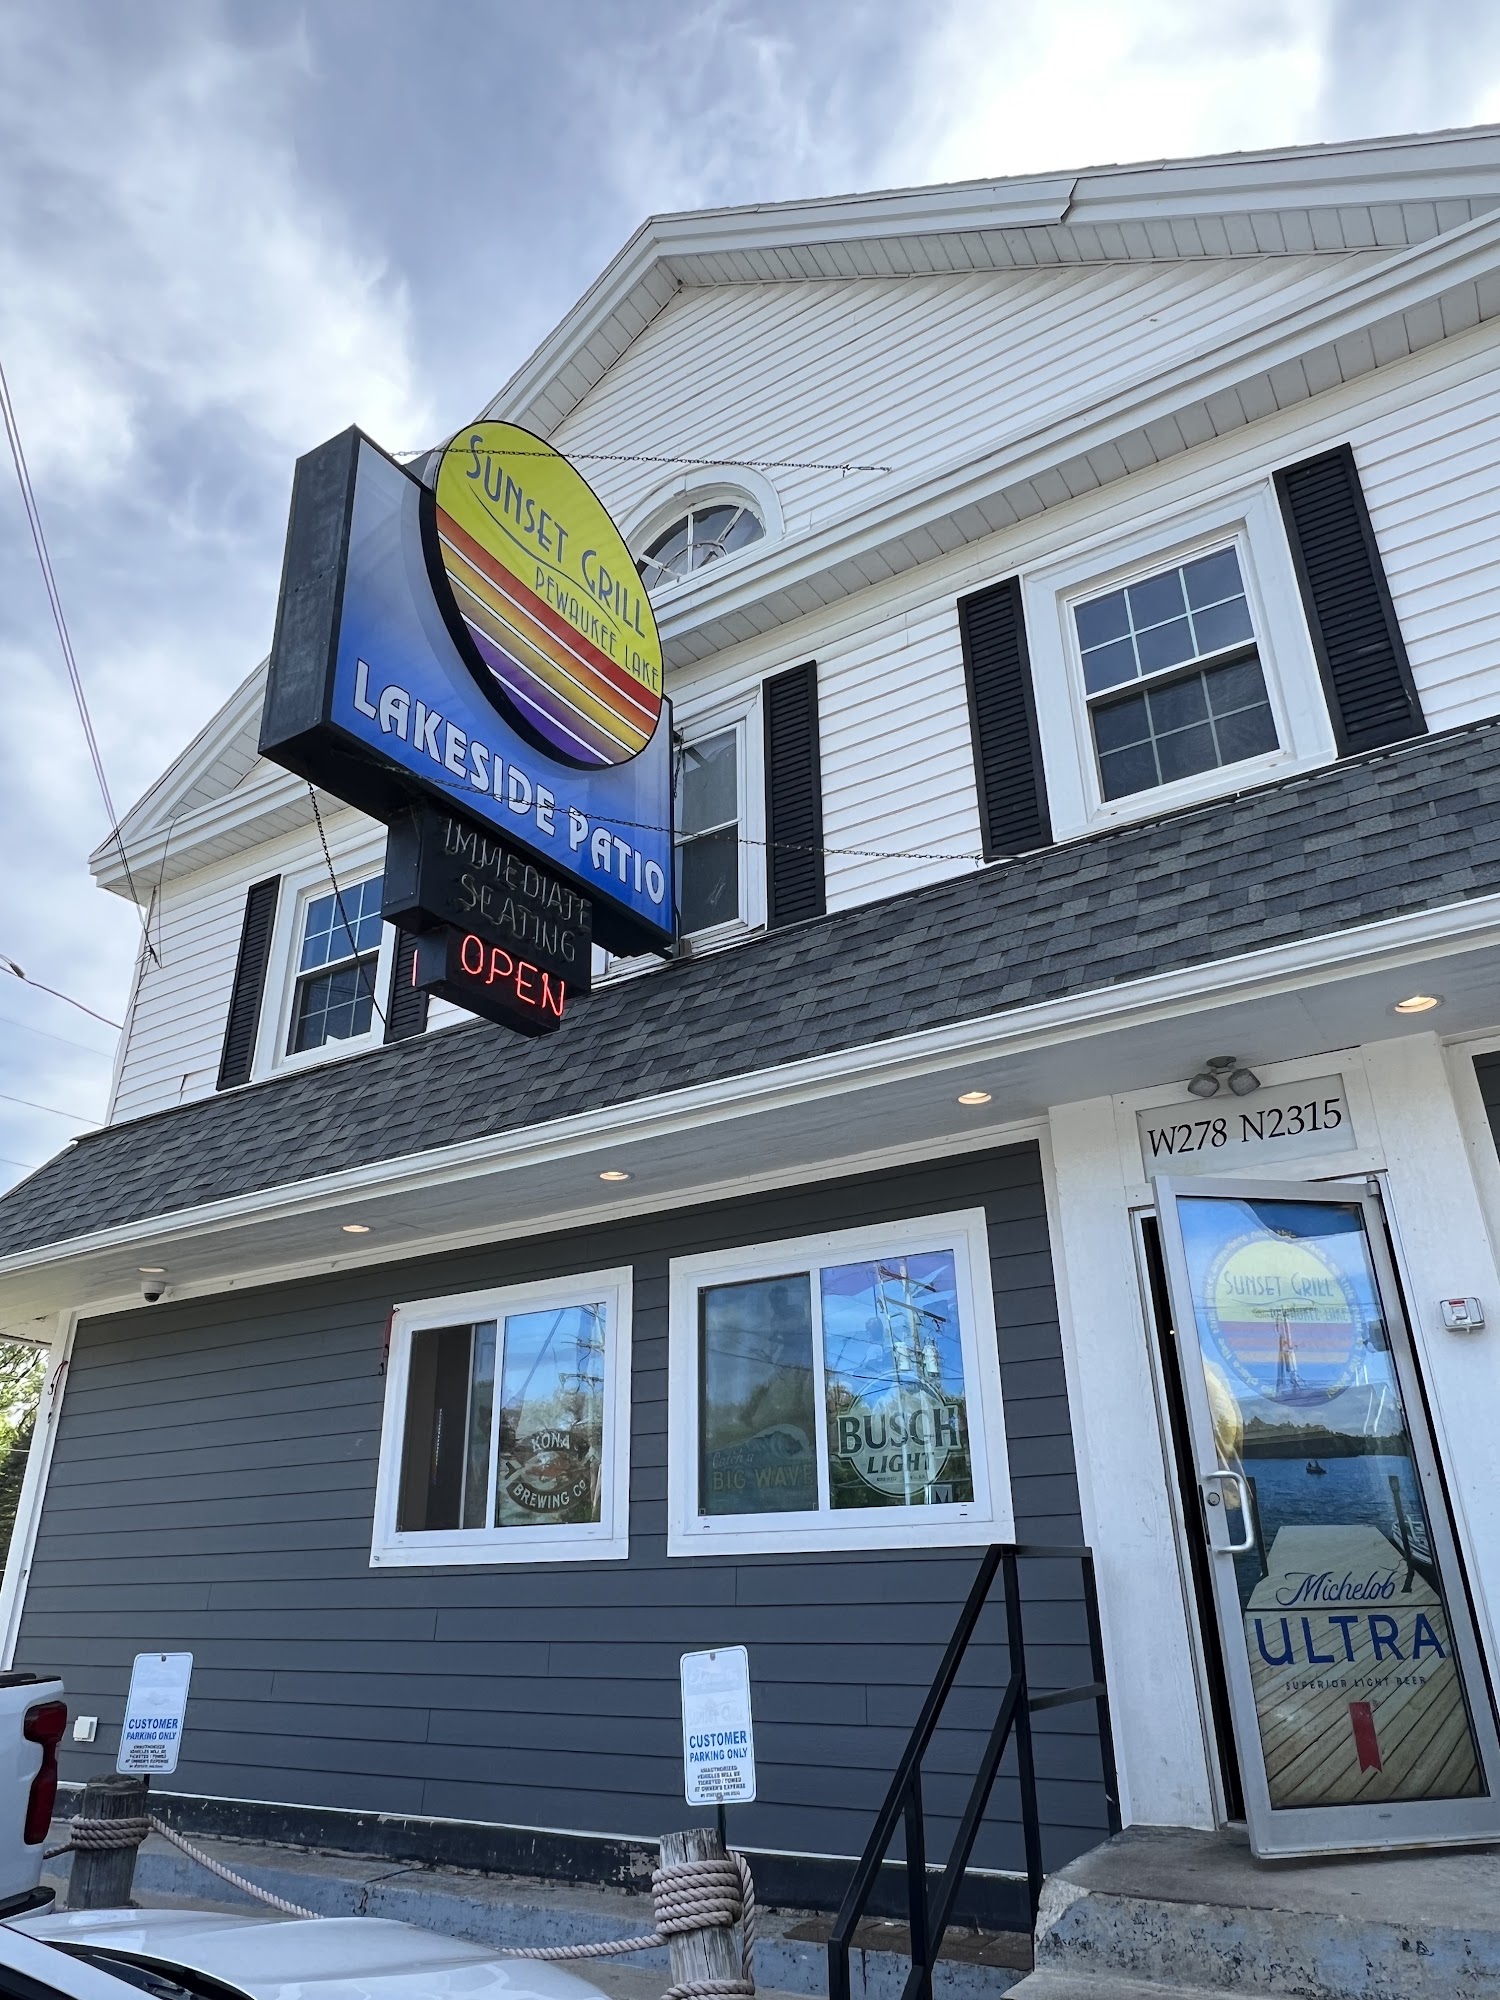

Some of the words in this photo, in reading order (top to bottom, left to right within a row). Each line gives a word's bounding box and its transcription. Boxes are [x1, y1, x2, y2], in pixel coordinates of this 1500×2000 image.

[466, 434, 569, 564] SUNSET
[581, 549, 646, 639] GRILL
[534, 565, 618, 659] PEWAUKEE
[625, 643, 659, 693] LAKE
[352, 657, 556, 838] LAKESIDE
[568, 805, 666, 906] PATIO
[444, 818, 593, 929] IMMEDIATE
[459, 873, 576, 962] SEATING
[460, 934, 566, 1017] OPEN
[1147, 1117, 1228, 1158] W278
[1238, 1097, 1343, 1144] N2315
[1223, 1269, 1285, 1297] SUNSET
[1290, 1270, 1335, 1298] GRILL
[838, 1407, 959, 1455] BUSCH
[712, 1469, 746, 1491] BIG
[753, 1463, 814, 1489] WAVE
[866, 1452, 935, 1475] LIGHT
[512, 1482, 570, 1509] BREWING
[1275, 1570, 1400, 1607] Michelob
[1254, 1612, 1447, 1667] ULTRA
[1285, 1678, 1348, 1691] SUPERIOR
[1354, 1676, 1389, 1688] LIGHT
[1396, 1675, 1427, 1686] BEER
[126, 1731, 157, 1741] PARKING
[158, 1731, 177, 1740] ONLY
[128, 1718, 179, 1729] CUSTOMER
[689, 1730, 747, 1749] CUSTOMER
[689, 1749, 725, 1763] PARKING
[727, 1747, 748, 1760] ONLY
